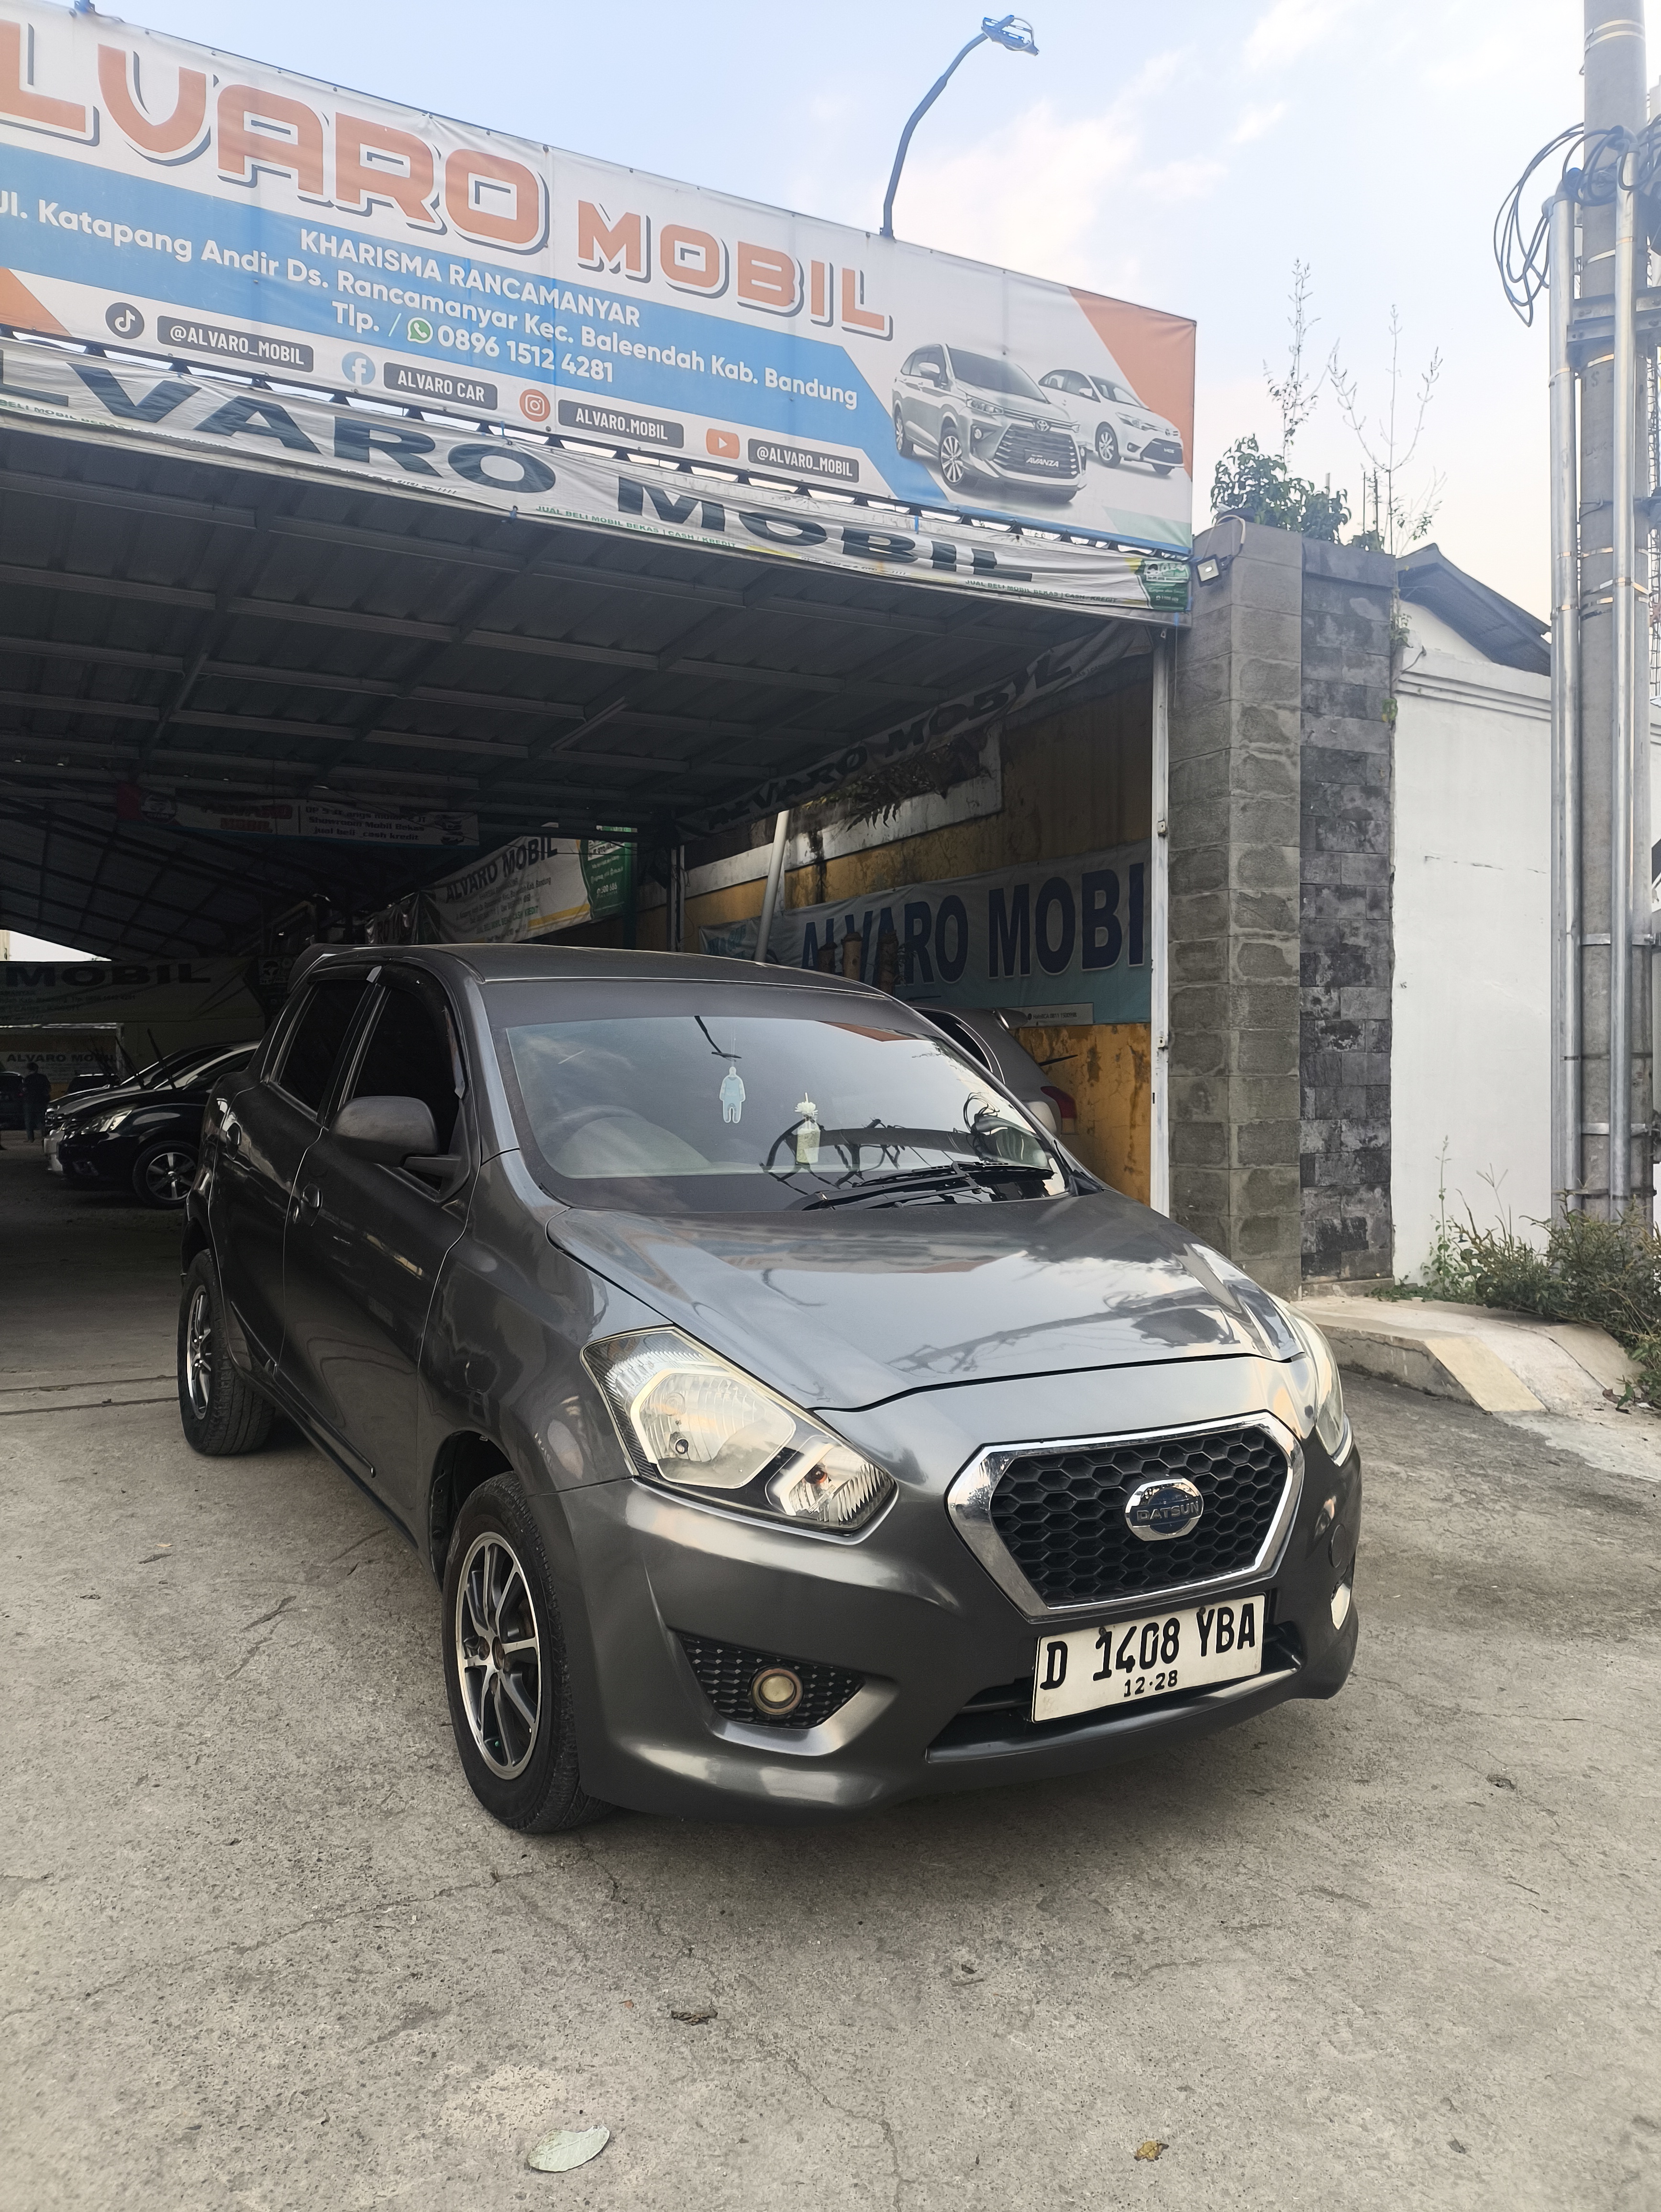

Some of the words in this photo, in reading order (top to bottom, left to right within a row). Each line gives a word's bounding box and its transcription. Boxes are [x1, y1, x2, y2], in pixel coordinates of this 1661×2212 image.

[301, 229, 442, 281] KHARISMA
[449, 264, 640, 327] RANCAMANYAR
[578, 199, 891, 339] MOBIL
[0, 190, 27, 219] Jl.
[39, 199, 192, 262] Katapang
[201, 240, 279, 276] Andir
[288, 258, 329, 288] Ds.
[338, 270, 518, 329] Rancamanyar
[525, 314, 573, 344] Kec.
[581, 326, 704, 372] Baleendah
[711, 355, 758, 384] Kab.
[765, 367, 857, 410] Bandung
[170, 323, 305, 365] @ALVARO_MOBIL
[332, 301, 379, 333] Tlp.
[438, 325, 499, 357] 0896
[507, 341, 555, 370] 1512
[562, 354, 613, 382] 4281
[398, 371, 452, 397] ALVARO
[456, 381, 485, 403] CAR
[576, 407, 668, 441] ALVARO.MOBIL
[756, 445, 853, 477] @ALVARO_MOBIL
[1026, 457, 1059, 467] AVANZA
[536, 506, 562, 514] JUAL
[566, 511, 588, 520] BELI
[592, 516, 623, 527] MOBIL
[626, 522, 659, 533] BEKAS
[668, 531, 694, 541] CASH
[618, 476, 1032, 583] MOBIL
[1005, 586, 1032, 594] MOBIL
[445, 861, 498, 903] ALVARO
[502, 838, 557, 877] MOBIL
[988, 863, 1144, 979] MOBI
[6, 964, 210, 986] MOBIL
[7, 1054, 66, 1062] ALVARO
[72, 1054, 116, 1062] MOL
[1136, 1501, 1199, 1521] DATSUN
[1040, 1641, 1068, 1690] D
[1093, 1618, 1180, 1681] 1408
[1196, 1603, 1255, 1657] YBA
